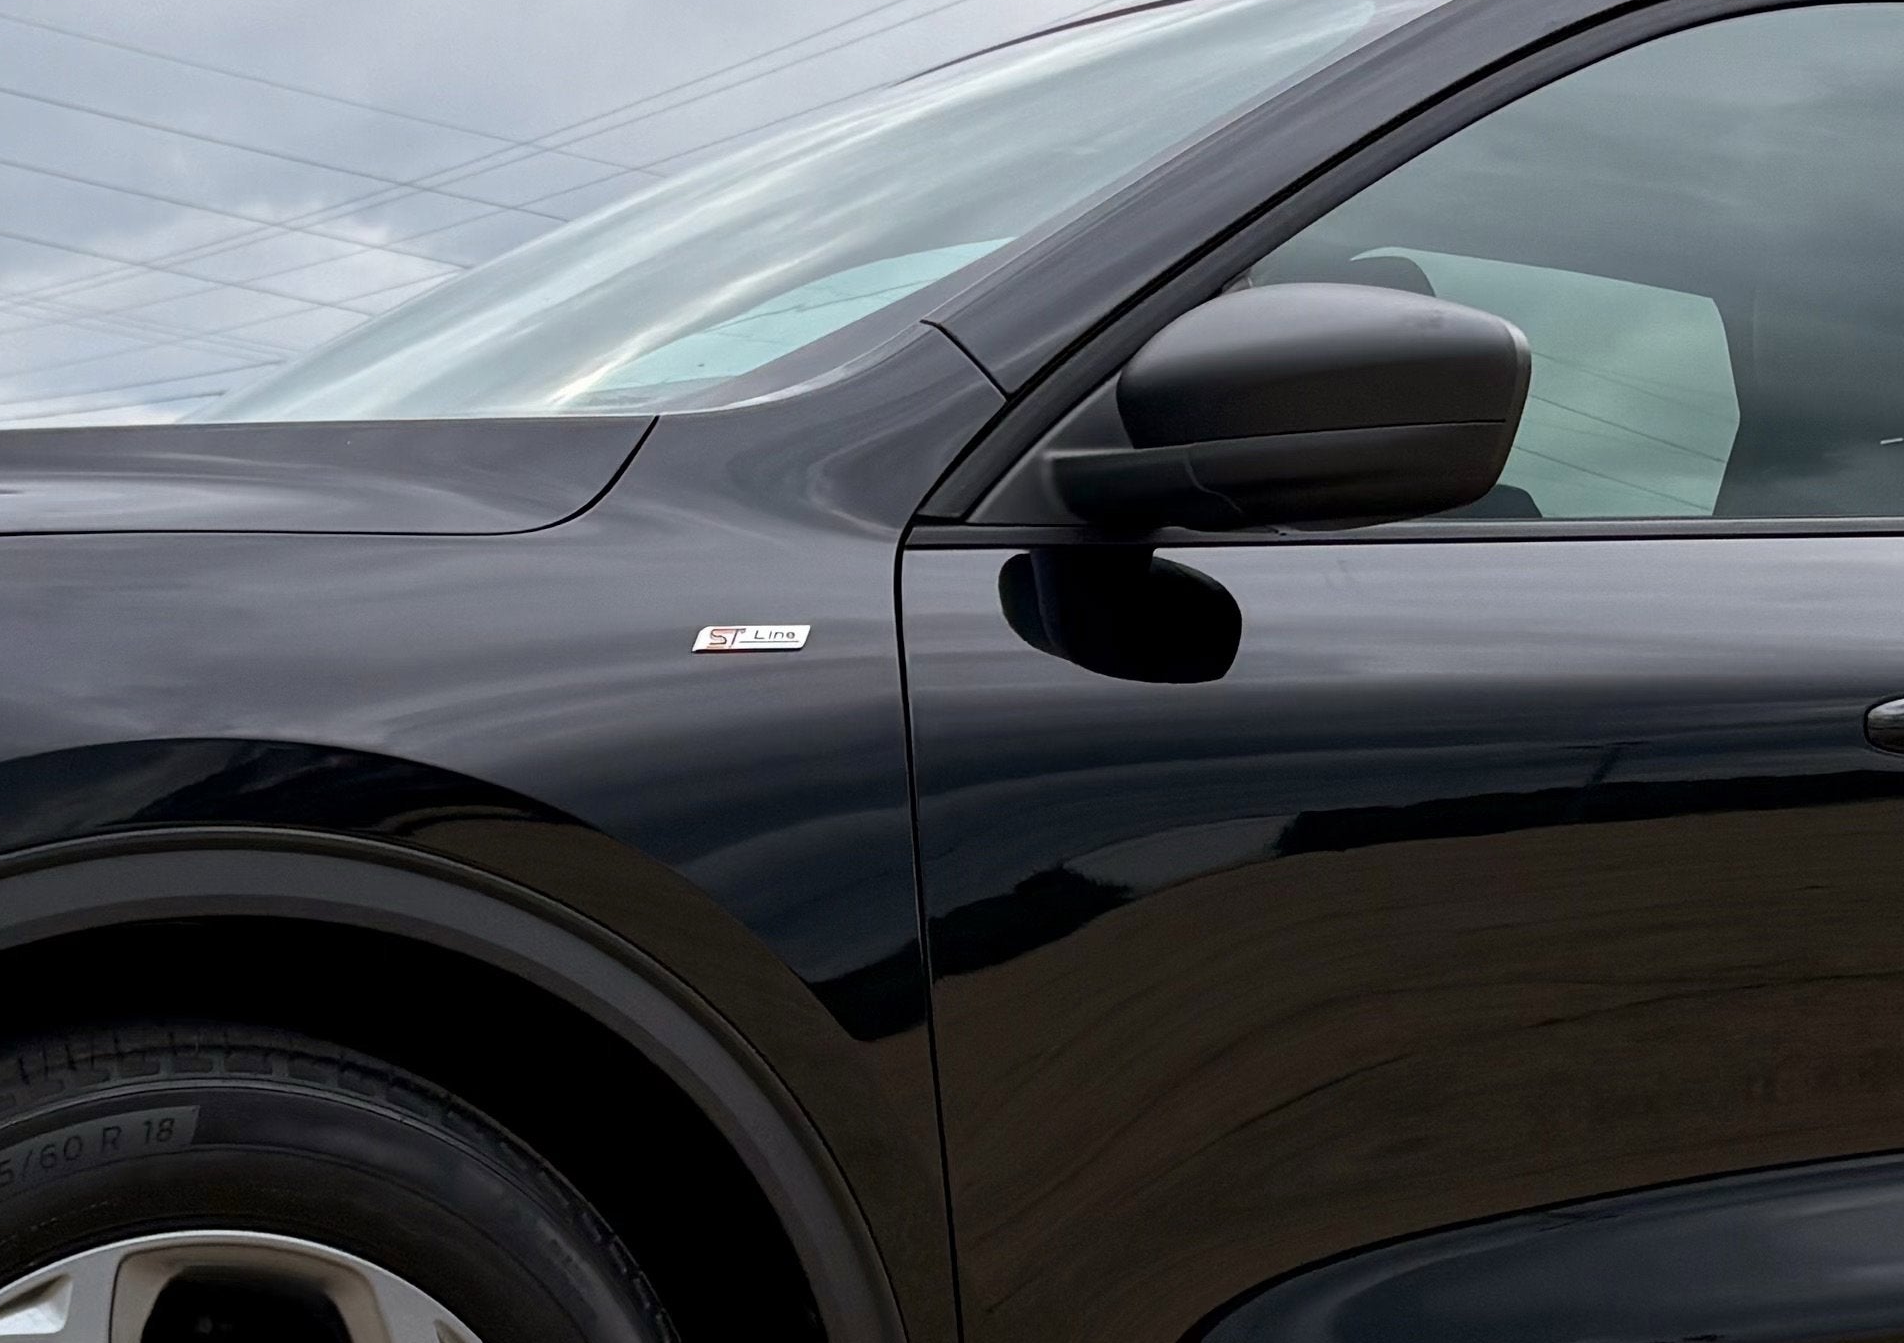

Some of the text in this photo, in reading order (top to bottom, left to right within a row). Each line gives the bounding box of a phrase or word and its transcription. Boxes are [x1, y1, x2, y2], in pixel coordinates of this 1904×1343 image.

[708, 627, 747, 648] ST
[101, 1124, 123, 1153] R
[143, 1117, 175, 1143] 18
